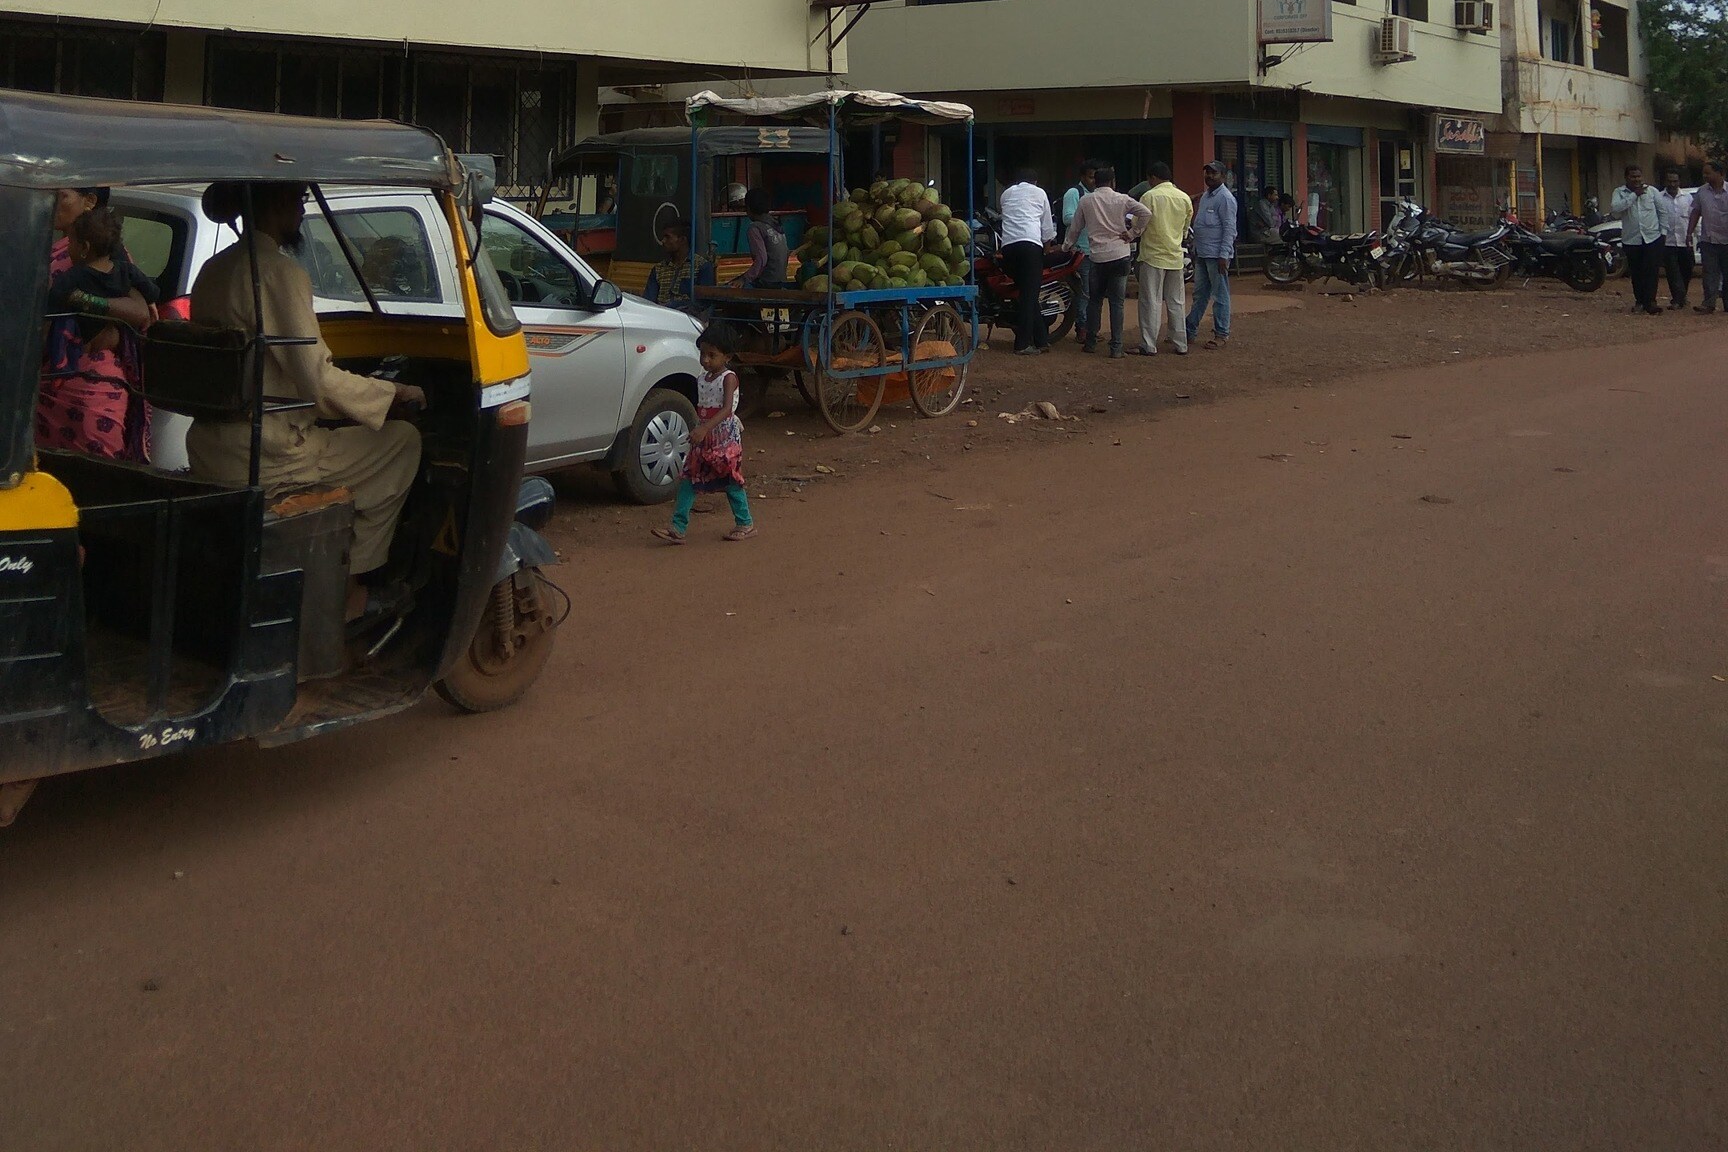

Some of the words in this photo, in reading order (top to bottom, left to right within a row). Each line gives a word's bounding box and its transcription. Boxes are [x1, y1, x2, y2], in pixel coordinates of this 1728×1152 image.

[530, 336, 551, 345] ALTO
[0, 556, 34, 574] Only
[139, 734, 158, 749] No
[160, 727, 196, 745] Entry
